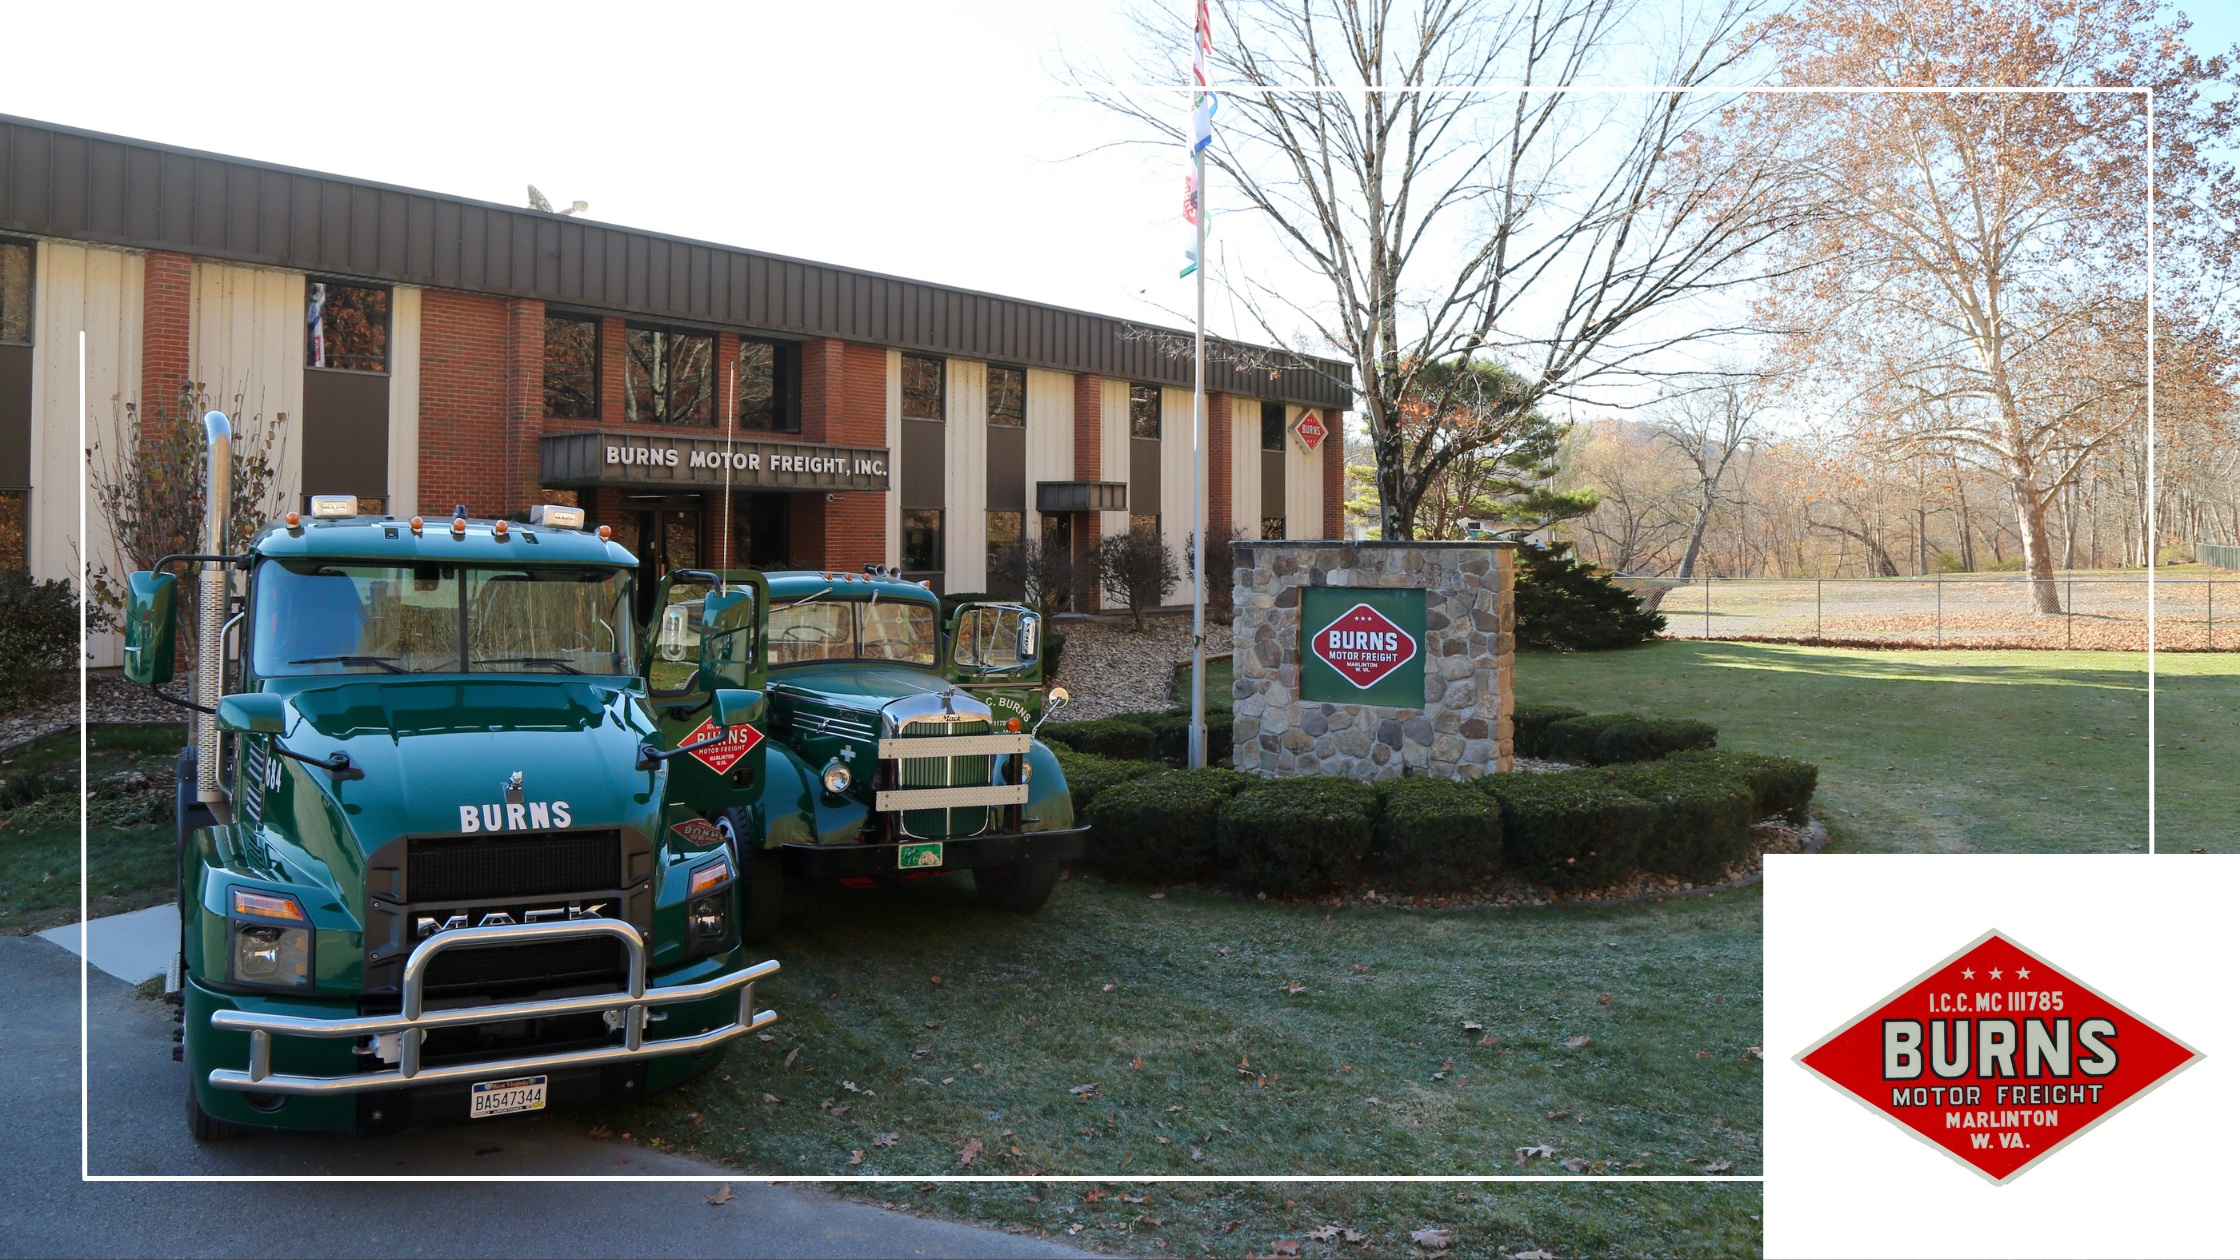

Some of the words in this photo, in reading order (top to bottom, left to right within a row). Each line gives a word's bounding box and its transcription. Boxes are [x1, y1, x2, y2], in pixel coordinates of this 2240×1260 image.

[1302, 424, 1321, 436] BURNS
[606, 446, 679, 467] BURNS
[689, 450, 760, 470] MOTOR
[770, 455, 850, 477] FREIGHT,
[854, 459, 888, 476] INC.
[1329, 630, 1398, 651] BURNS
[1329, 651, 1359, 660] MOTOR
[1361, 652, 1398, 662] FREIGHT
[998, 697, 1031, 722] BURNS
[697, 728, 748, 747] BUNS
[720, 744, 745, 752] FREIGHT
[265, 756, 282, 793] 684
[459, 800, 572, 834] BURNS
[475, 1088, 542, 1111] BA547344
